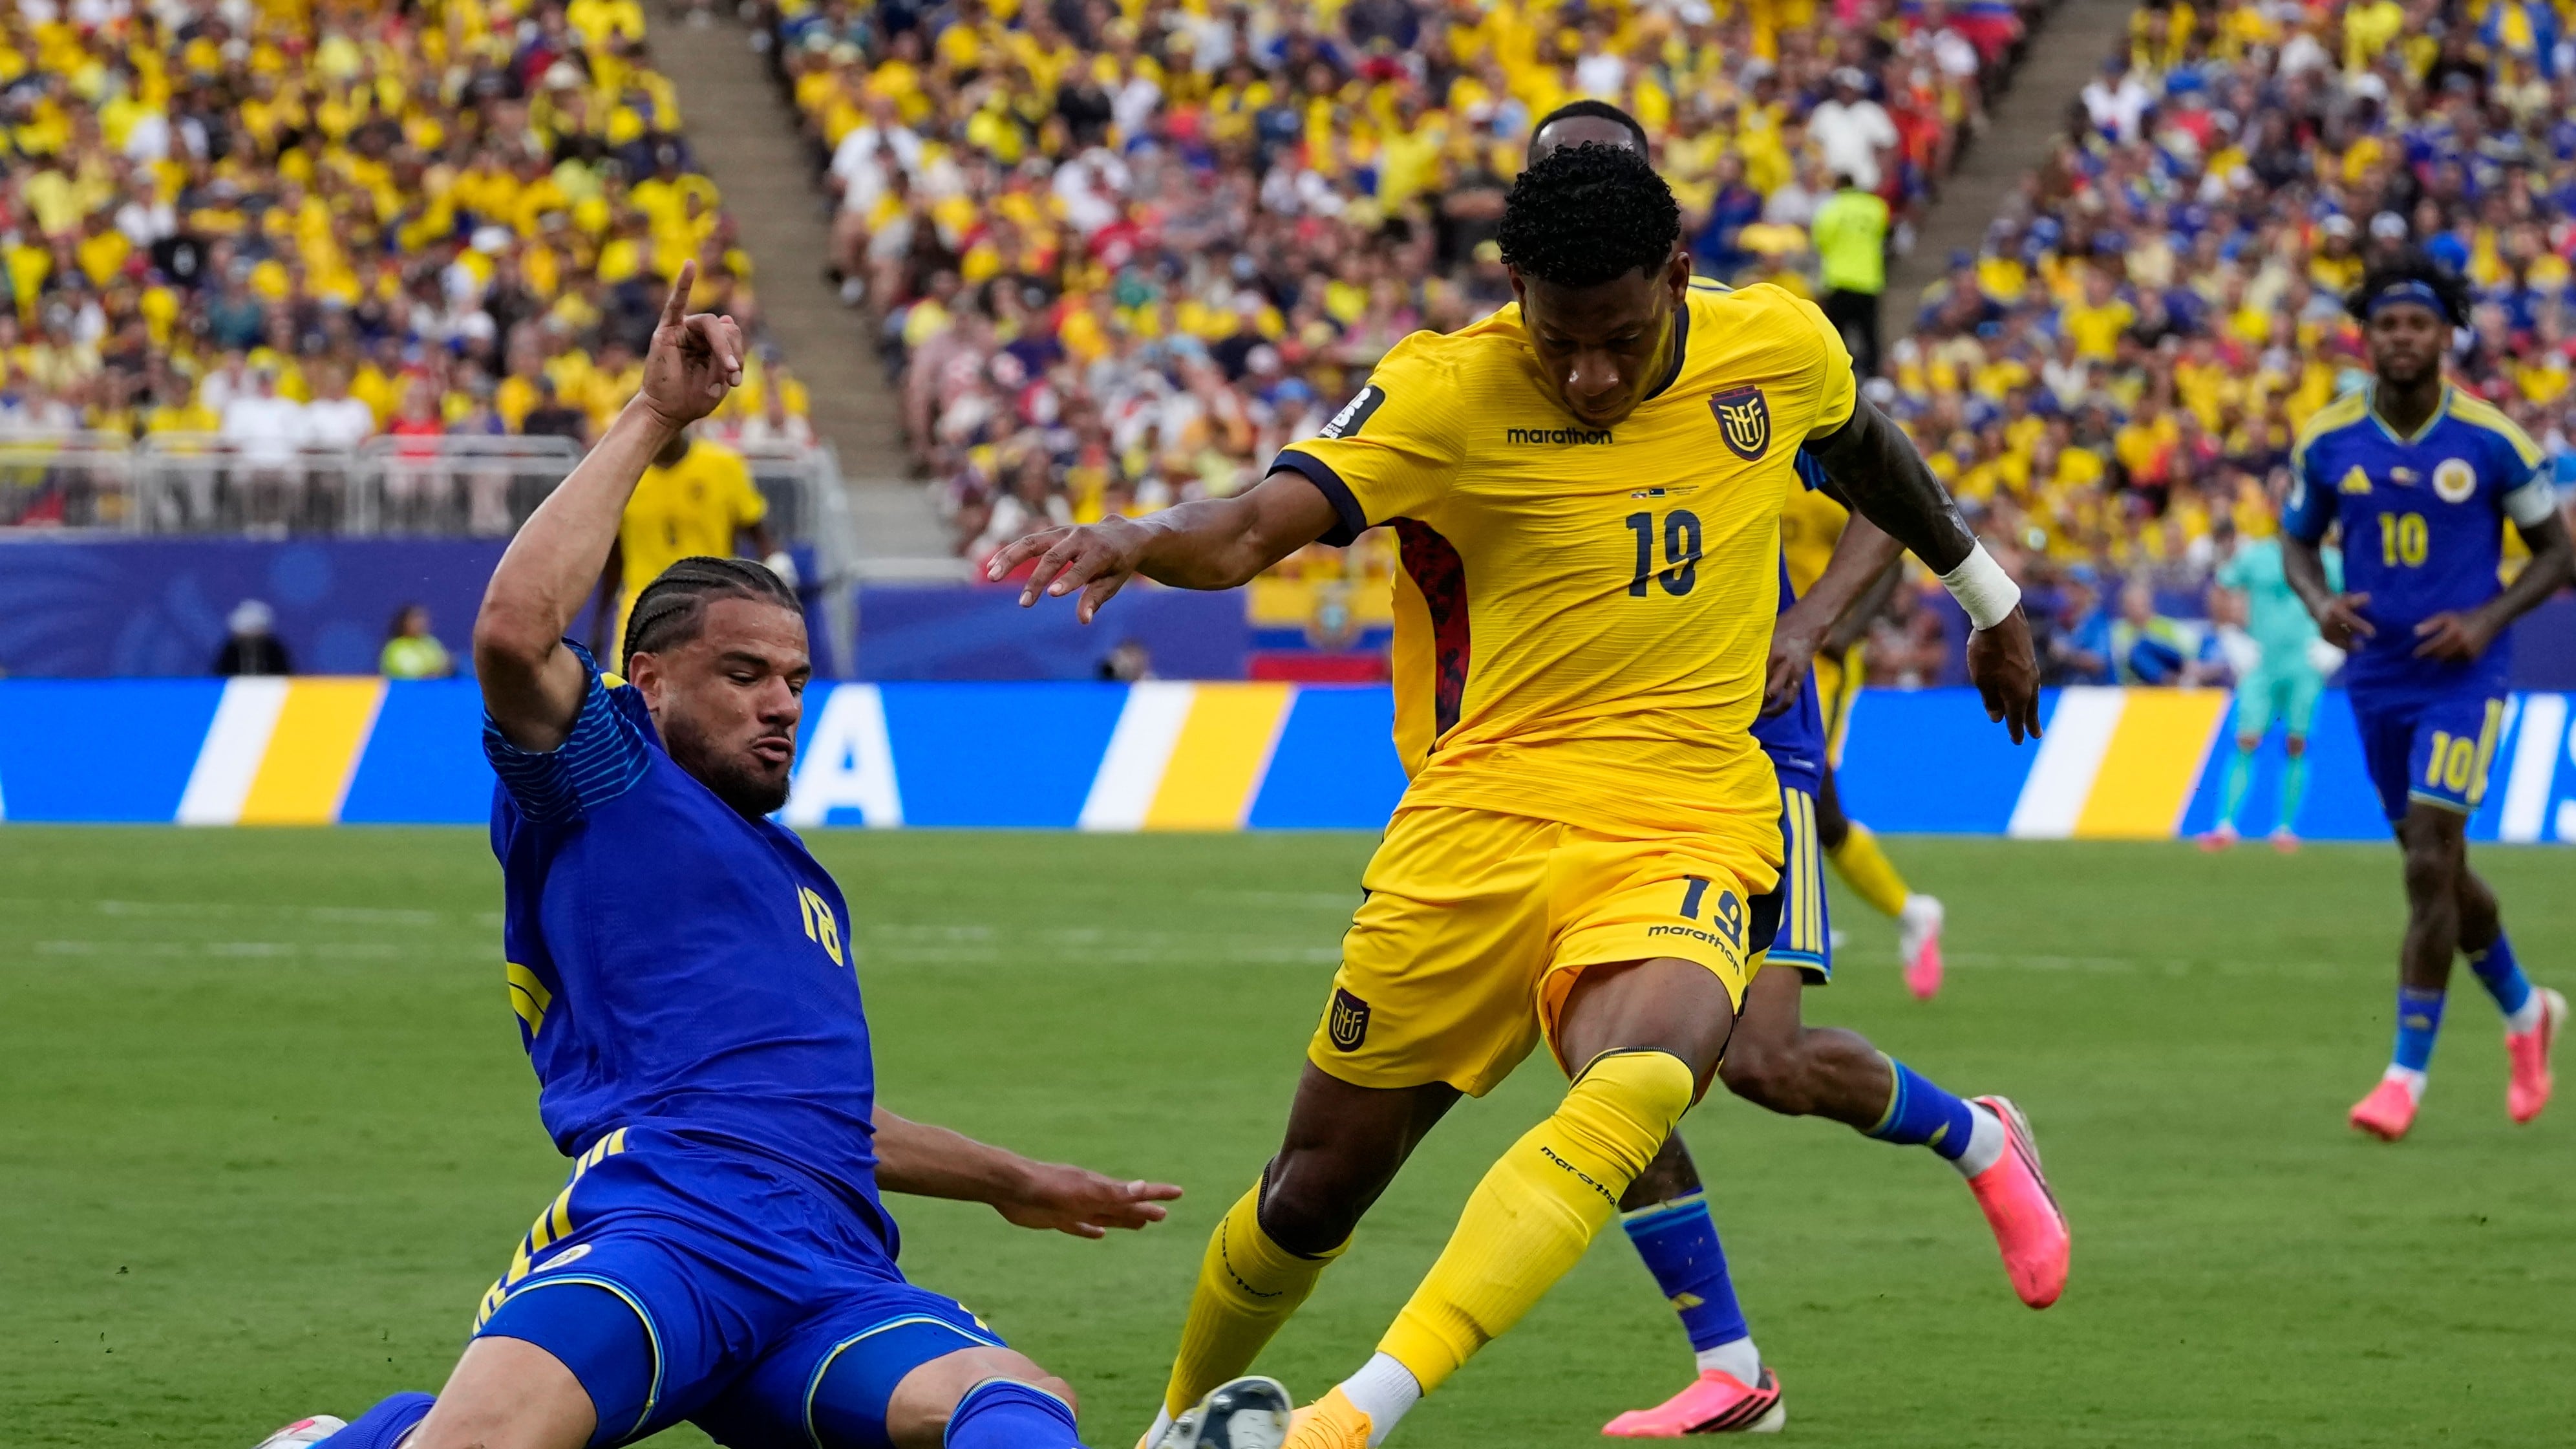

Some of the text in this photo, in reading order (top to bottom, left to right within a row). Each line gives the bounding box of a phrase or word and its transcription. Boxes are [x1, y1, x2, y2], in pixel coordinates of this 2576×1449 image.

[1507, 427, 1613, 445] marathon
[1626, 510, 1702, 597] 19
[2378, 512, 2429, 568] 10
[2426, 730, 2476, 793] 10
[795, 882, 844, 967] 18
[1679, 875, 1742, 950] 19
[1648, 925, 1740, 976] marathon
[1540, 1146, 1617, 1208] maratho
